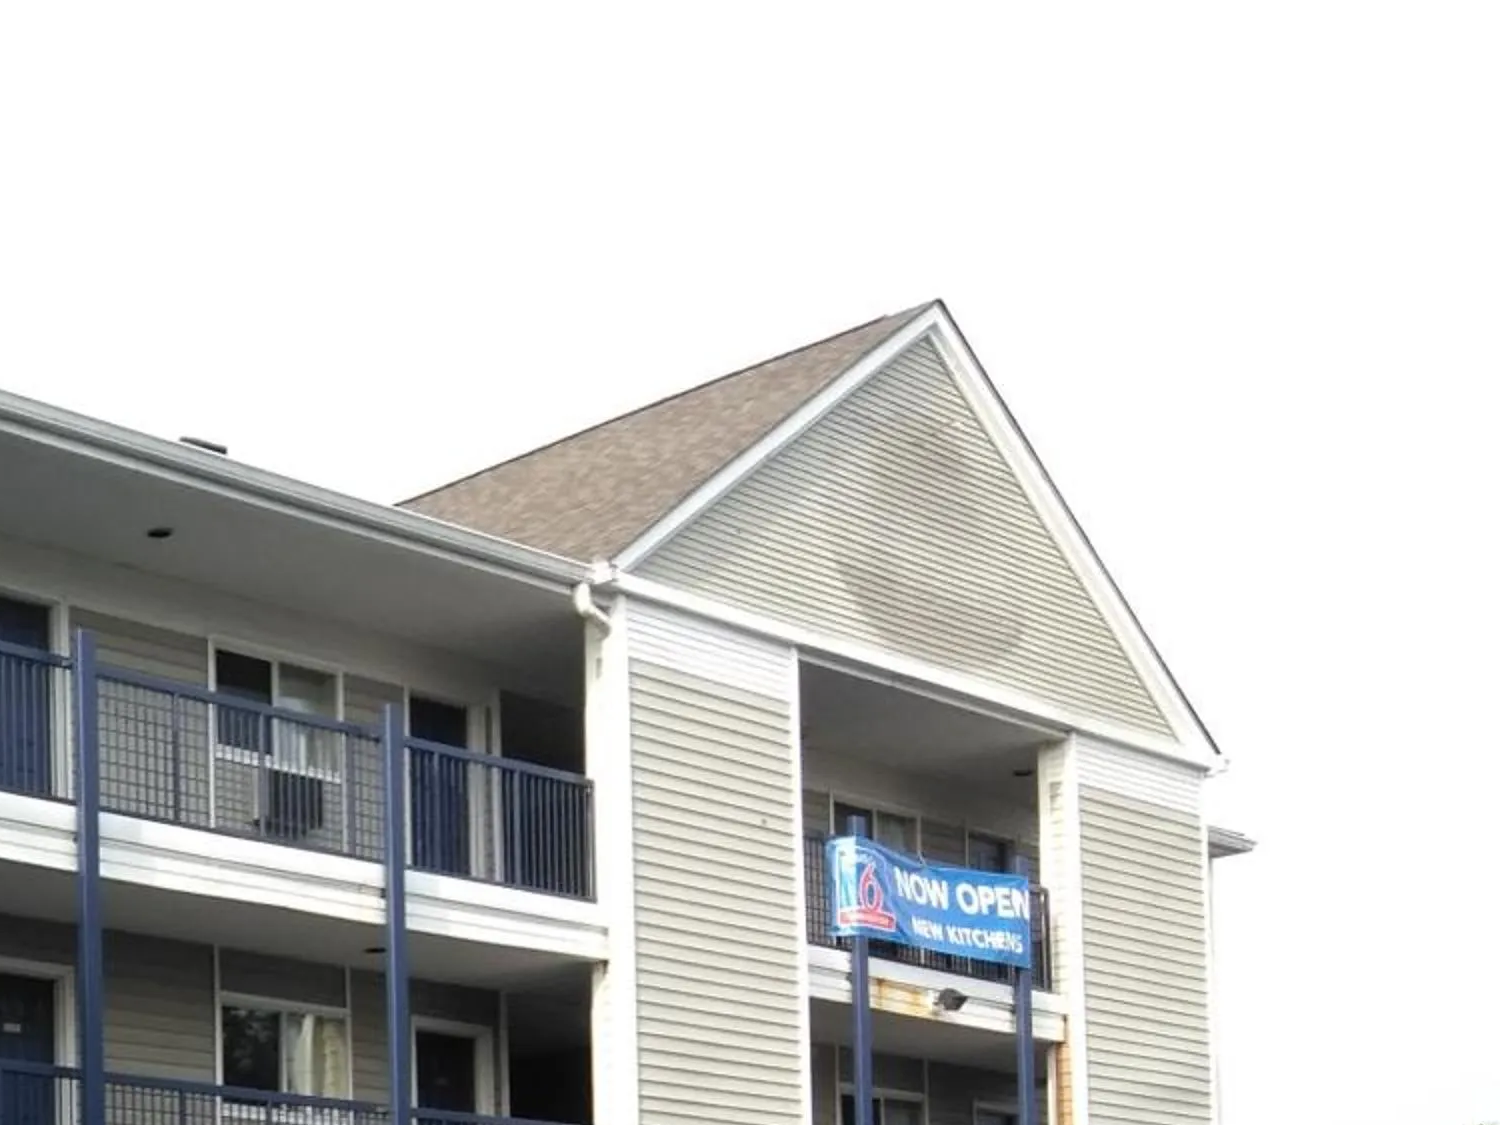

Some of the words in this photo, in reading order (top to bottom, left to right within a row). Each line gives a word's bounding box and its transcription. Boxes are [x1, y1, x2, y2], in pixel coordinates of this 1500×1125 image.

[894, 867, 948, 910] NOW
[955, 882, 1030, 920] OPEN
[911, 916, 944, 942] NEW
[946, 923, 1024, 954] KITCHENS
